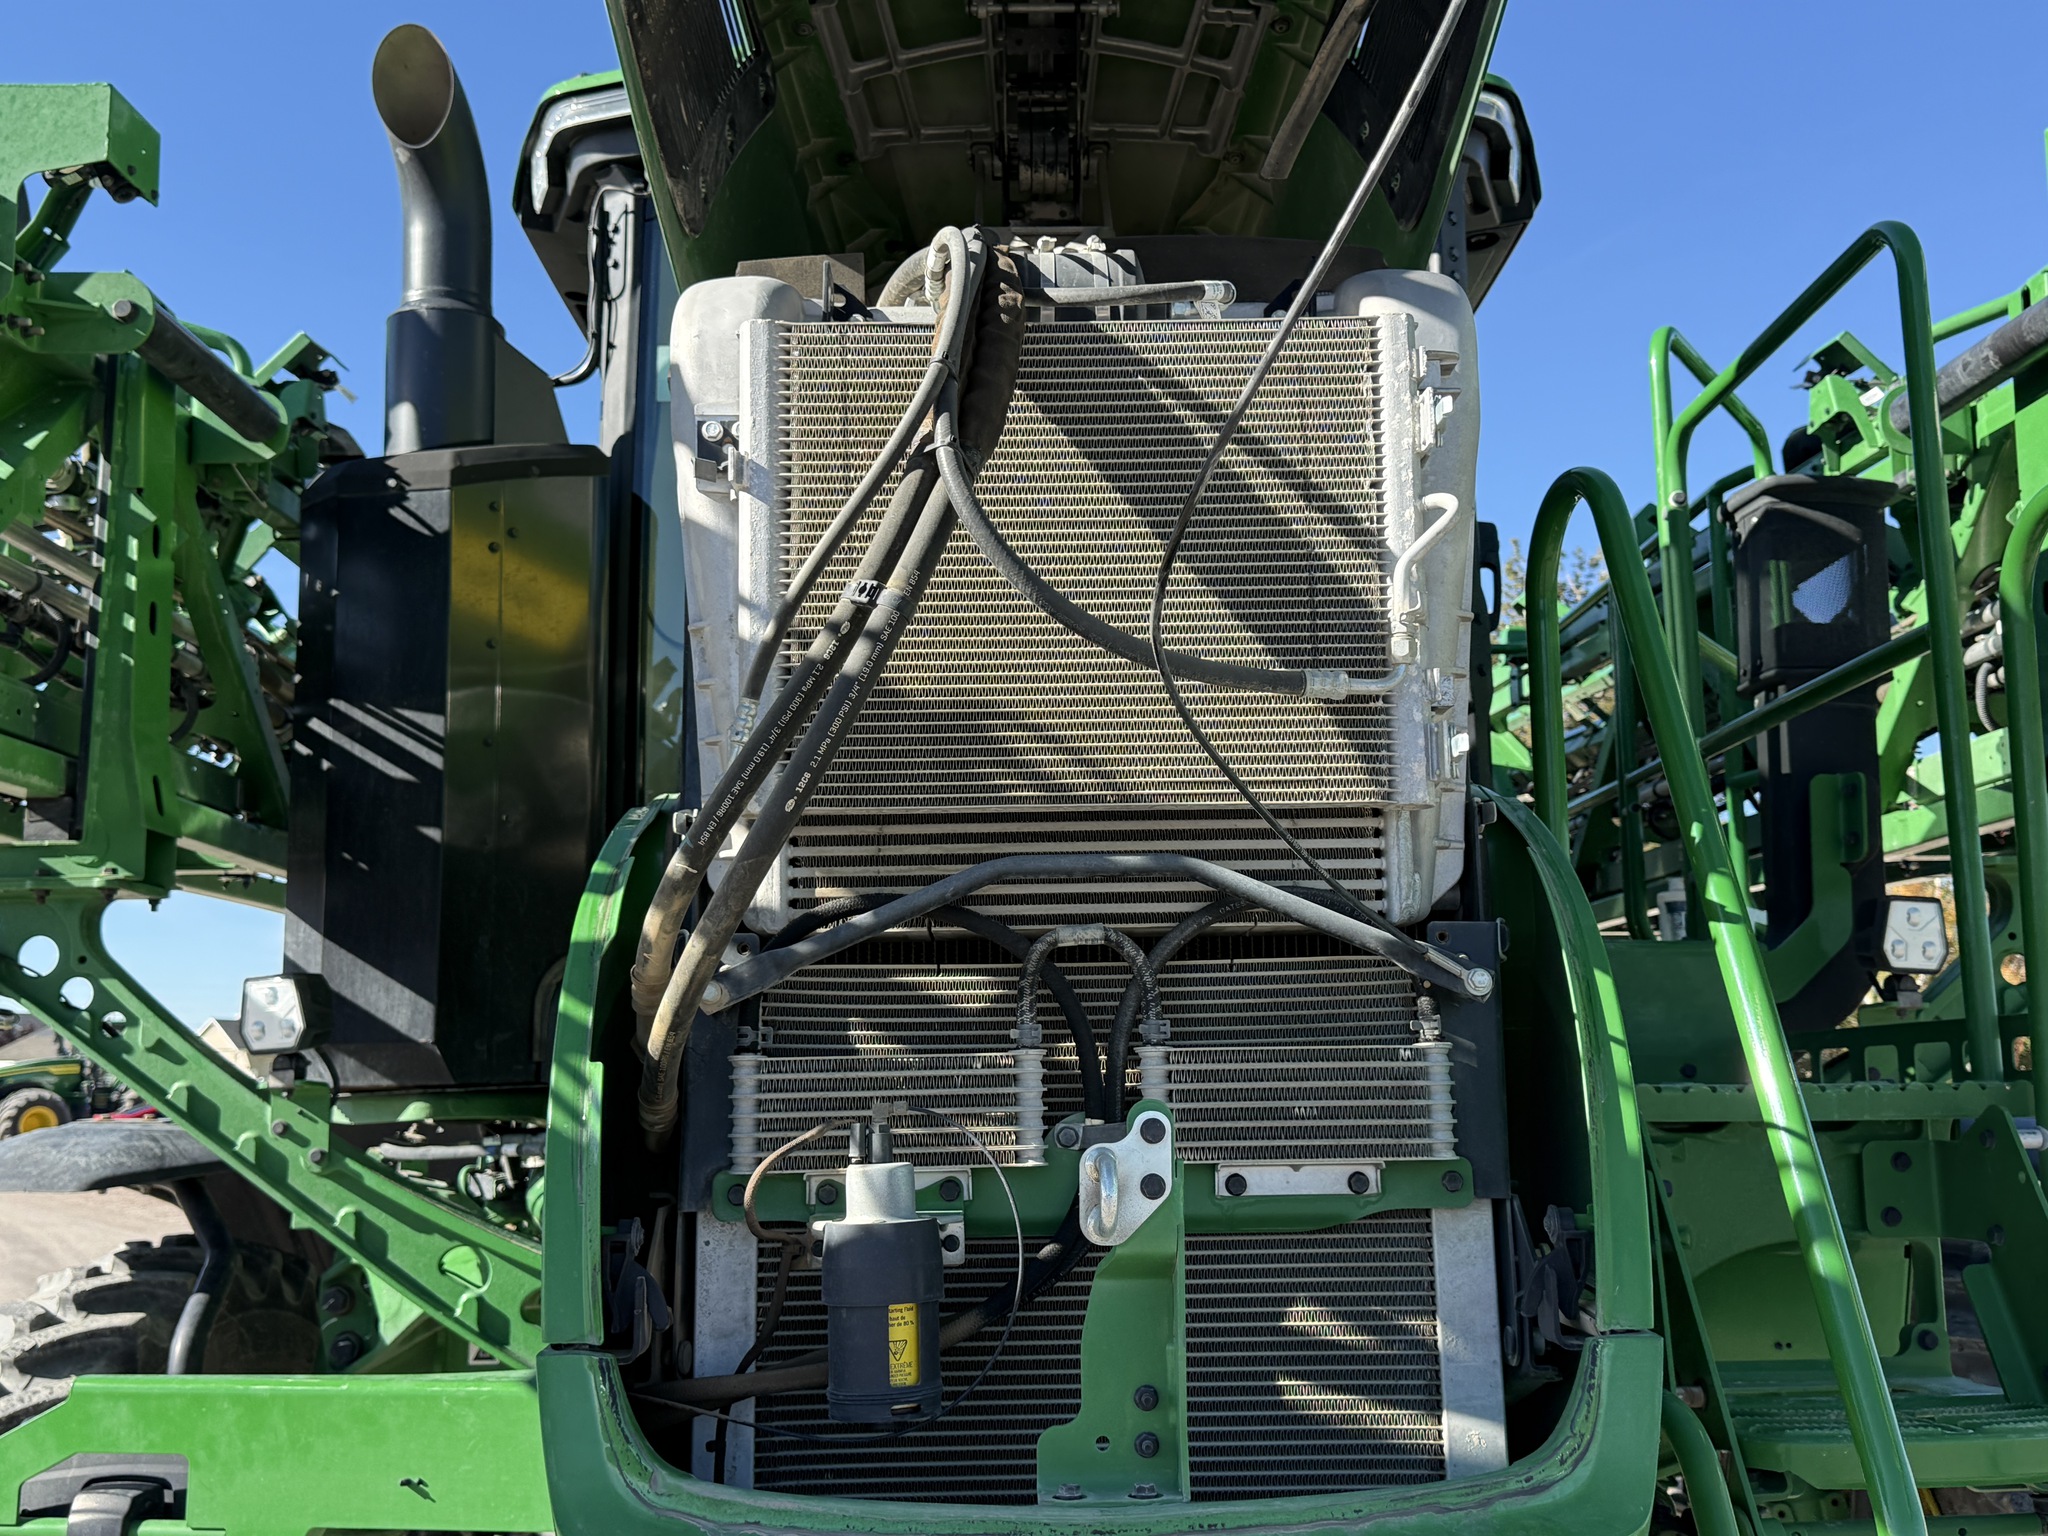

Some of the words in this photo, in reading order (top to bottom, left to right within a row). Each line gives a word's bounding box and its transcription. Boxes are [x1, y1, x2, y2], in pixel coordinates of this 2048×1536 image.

[809, 755, 822, 769] 2.1
[817, 737, 831, 755] MPa
[827, 717, 842, 737] (300
[839, 701, 853, 718] PSI)
[871, 641, 884, 661] mm)
[880, 624, 893, 641] SAE
[903, 585, 914, 597] EN
[910, 569, 921, 585] 854
[811, 663, 825, 676] 2.1
[801, 675, 816, 692] MPa
[790, 692, 805, 711] (300
[777, 711, 793, 727] PSI)
[741, 761, 756, 780] mm)
[731, 779, 745, 796] SAE
[716, 793, 735, 818] 100R6
[706, 820, 717, 833] EN
[698, 830, 711, 846] 854
